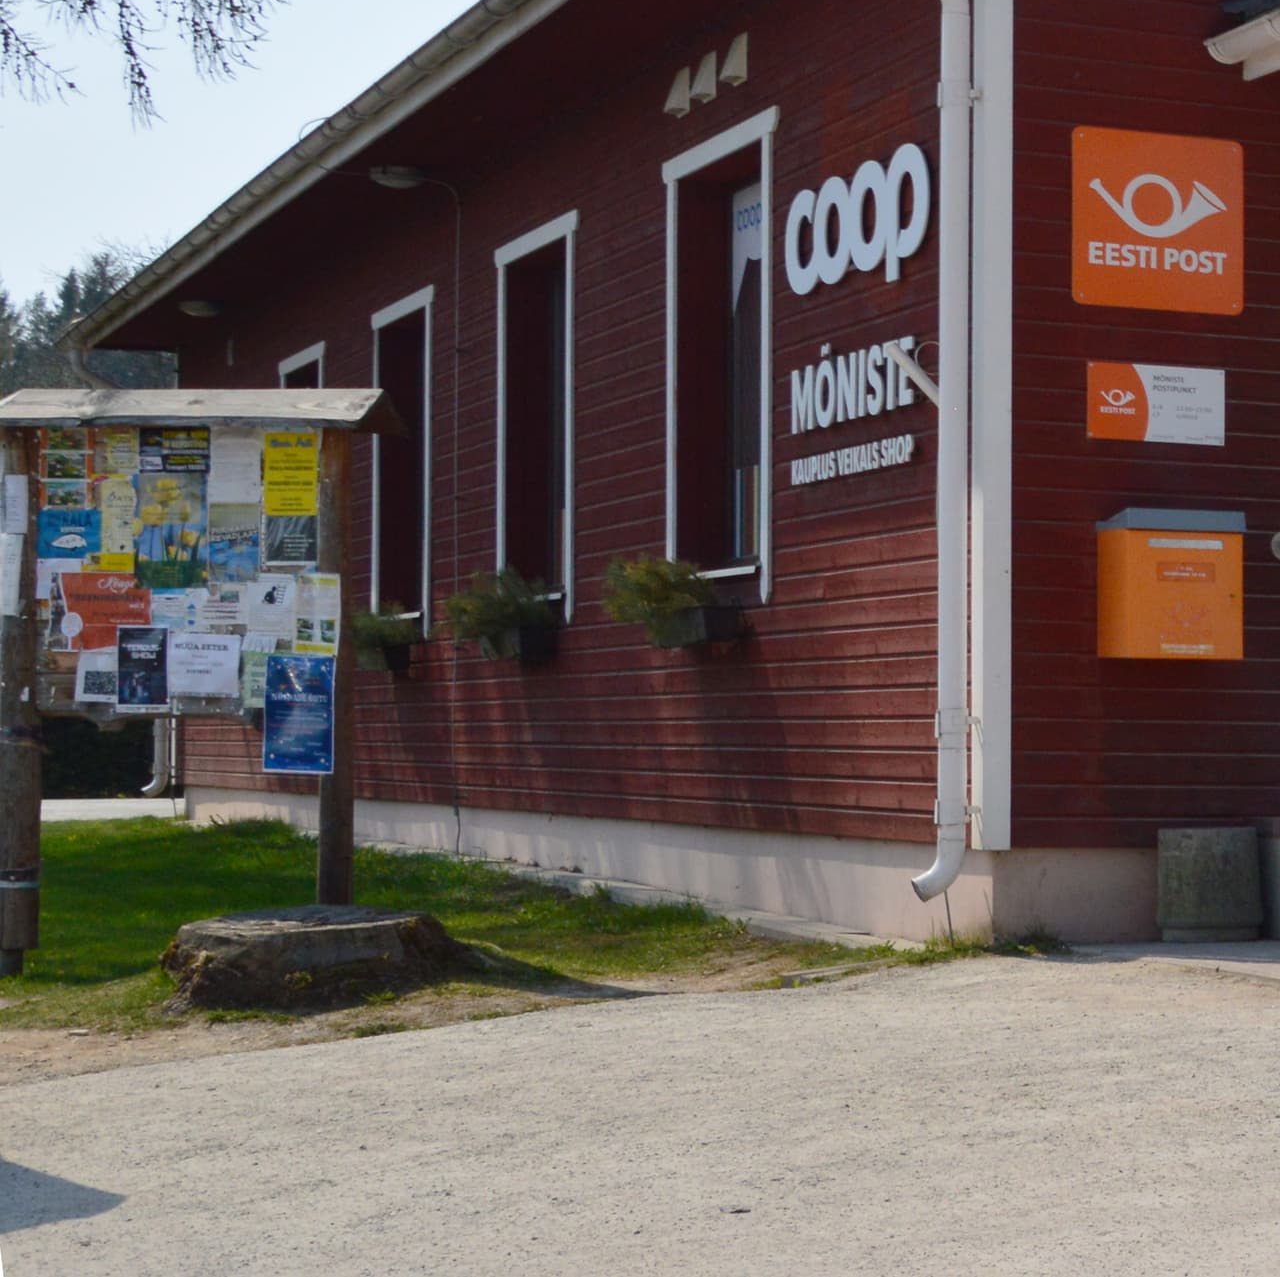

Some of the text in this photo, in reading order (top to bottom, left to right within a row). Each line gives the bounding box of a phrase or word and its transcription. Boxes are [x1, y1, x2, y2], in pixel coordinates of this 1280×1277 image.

[785, 143, 930, 295] coop
[1088, 241, 1228, 275] EESTI POST
[791, 335, 915, 435] MÕNISTE
[791, 433, 914, 486] KAUPLUS VEIKALS SHOP
